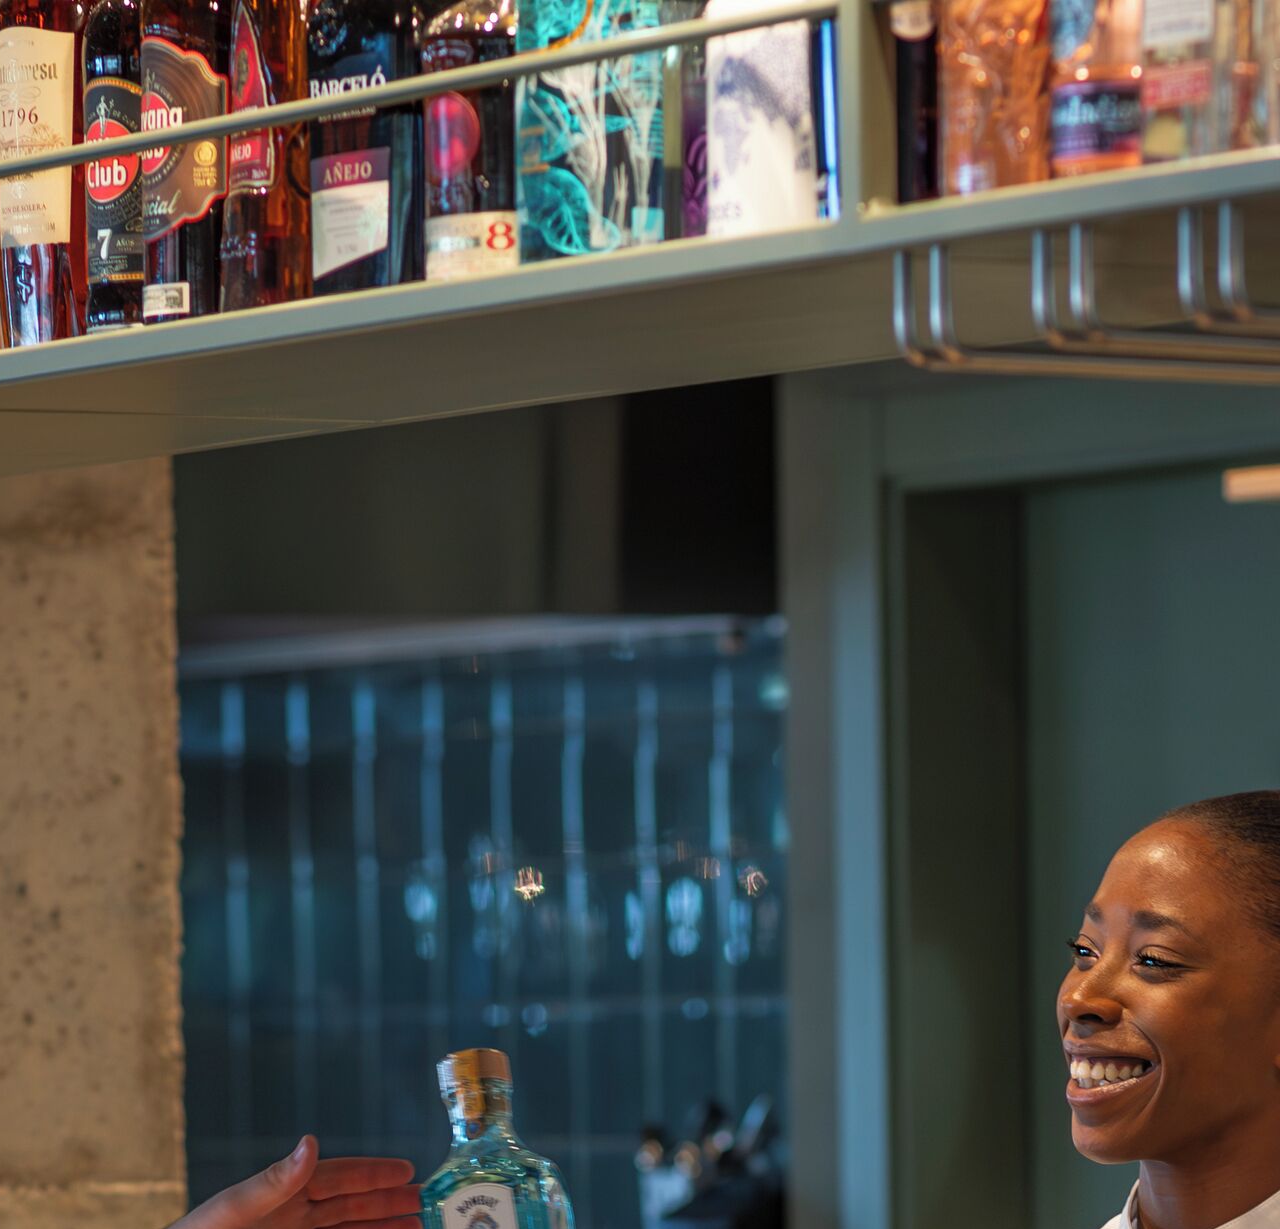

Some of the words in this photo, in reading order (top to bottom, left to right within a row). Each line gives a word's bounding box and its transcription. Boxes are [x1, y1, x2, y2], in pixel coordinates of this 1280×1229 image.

[310, 65, 386, 99] BARCELÓ
[2, 106, 39, 128] 1796
[88, 158, 127, 188] Club
[323, 160, 372, 185] AÑEJO
[97, 228, 111, 260] 7
[486, 221, 515, 251] 8
